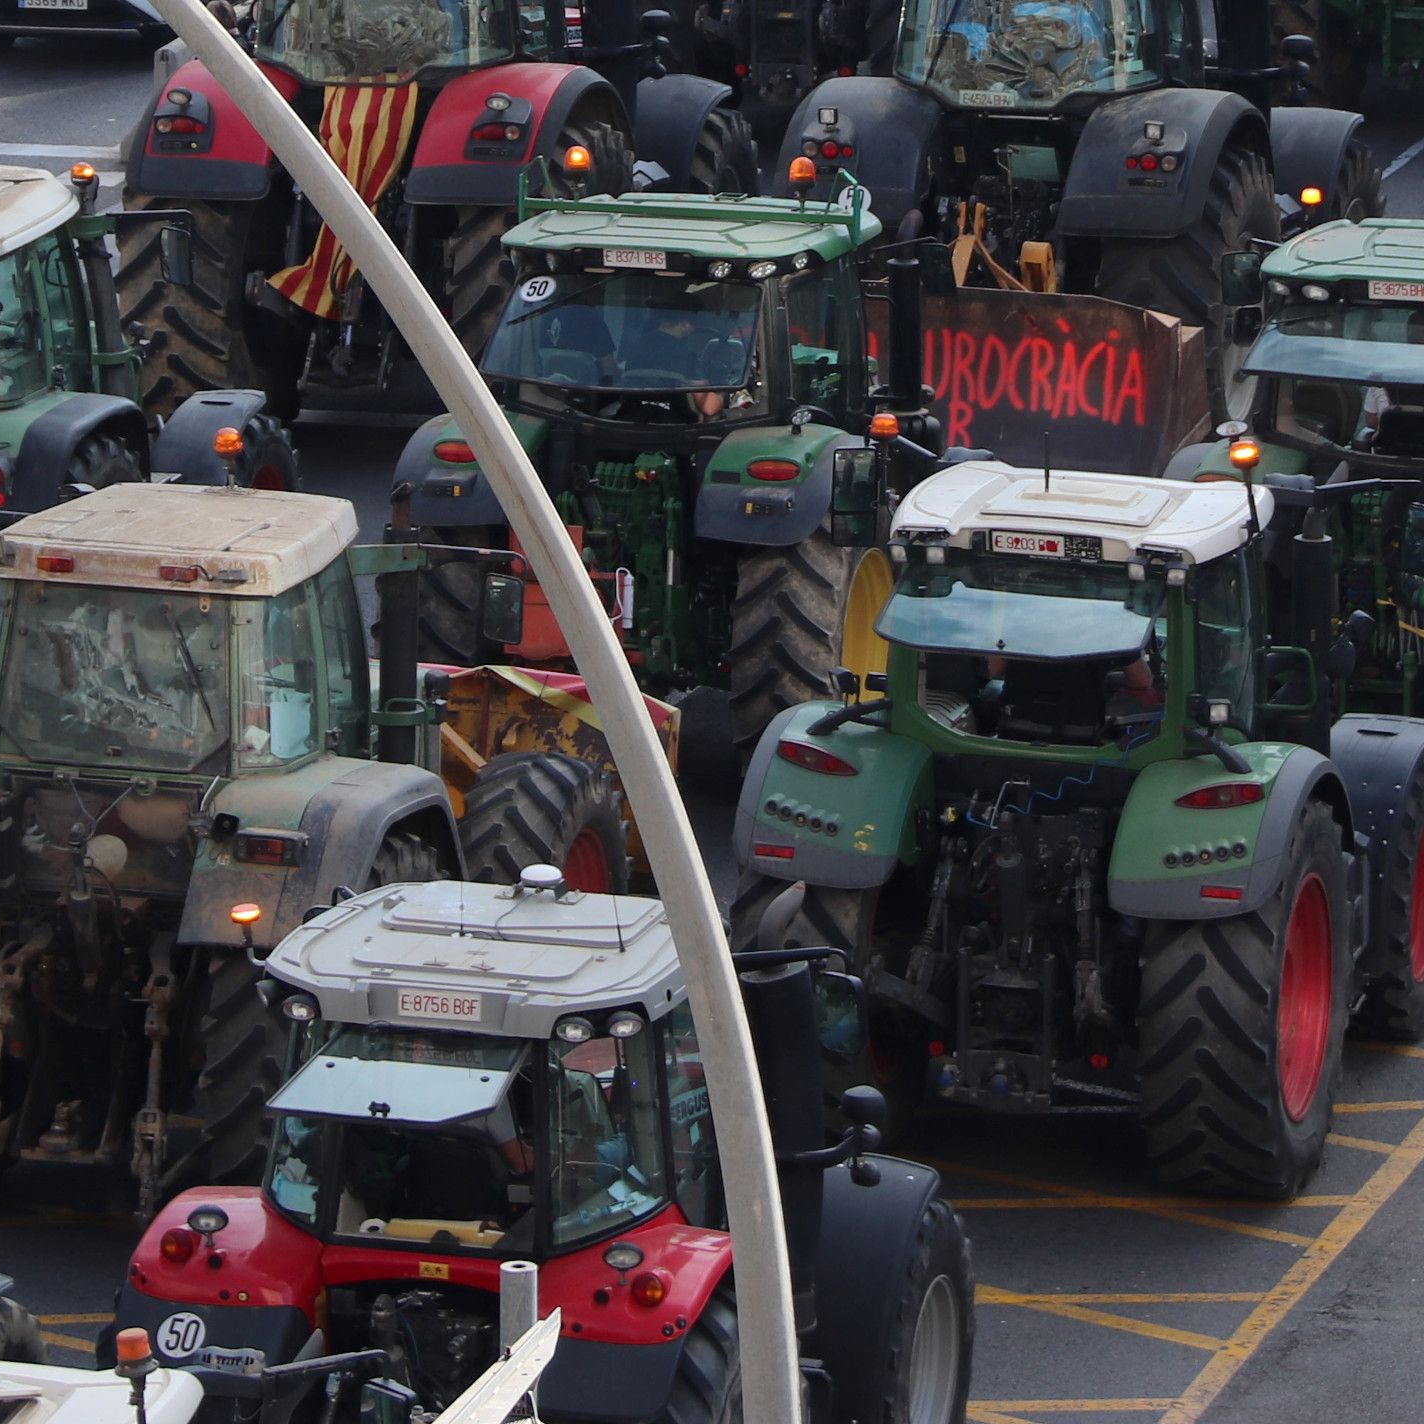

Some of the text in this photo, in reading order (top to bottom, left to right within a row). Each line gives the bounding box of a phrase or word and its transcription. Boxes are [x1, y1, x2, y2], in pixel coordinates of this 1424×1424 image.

[606, 250, 614, 263] E
[643, 252, 665, 266] BHS
[527, 280, 549, 297] 50
[994, 536, 1003, 549] E
[453, 997, 480, 1016] BGF
[165, 1317, 202, 1353] 50
